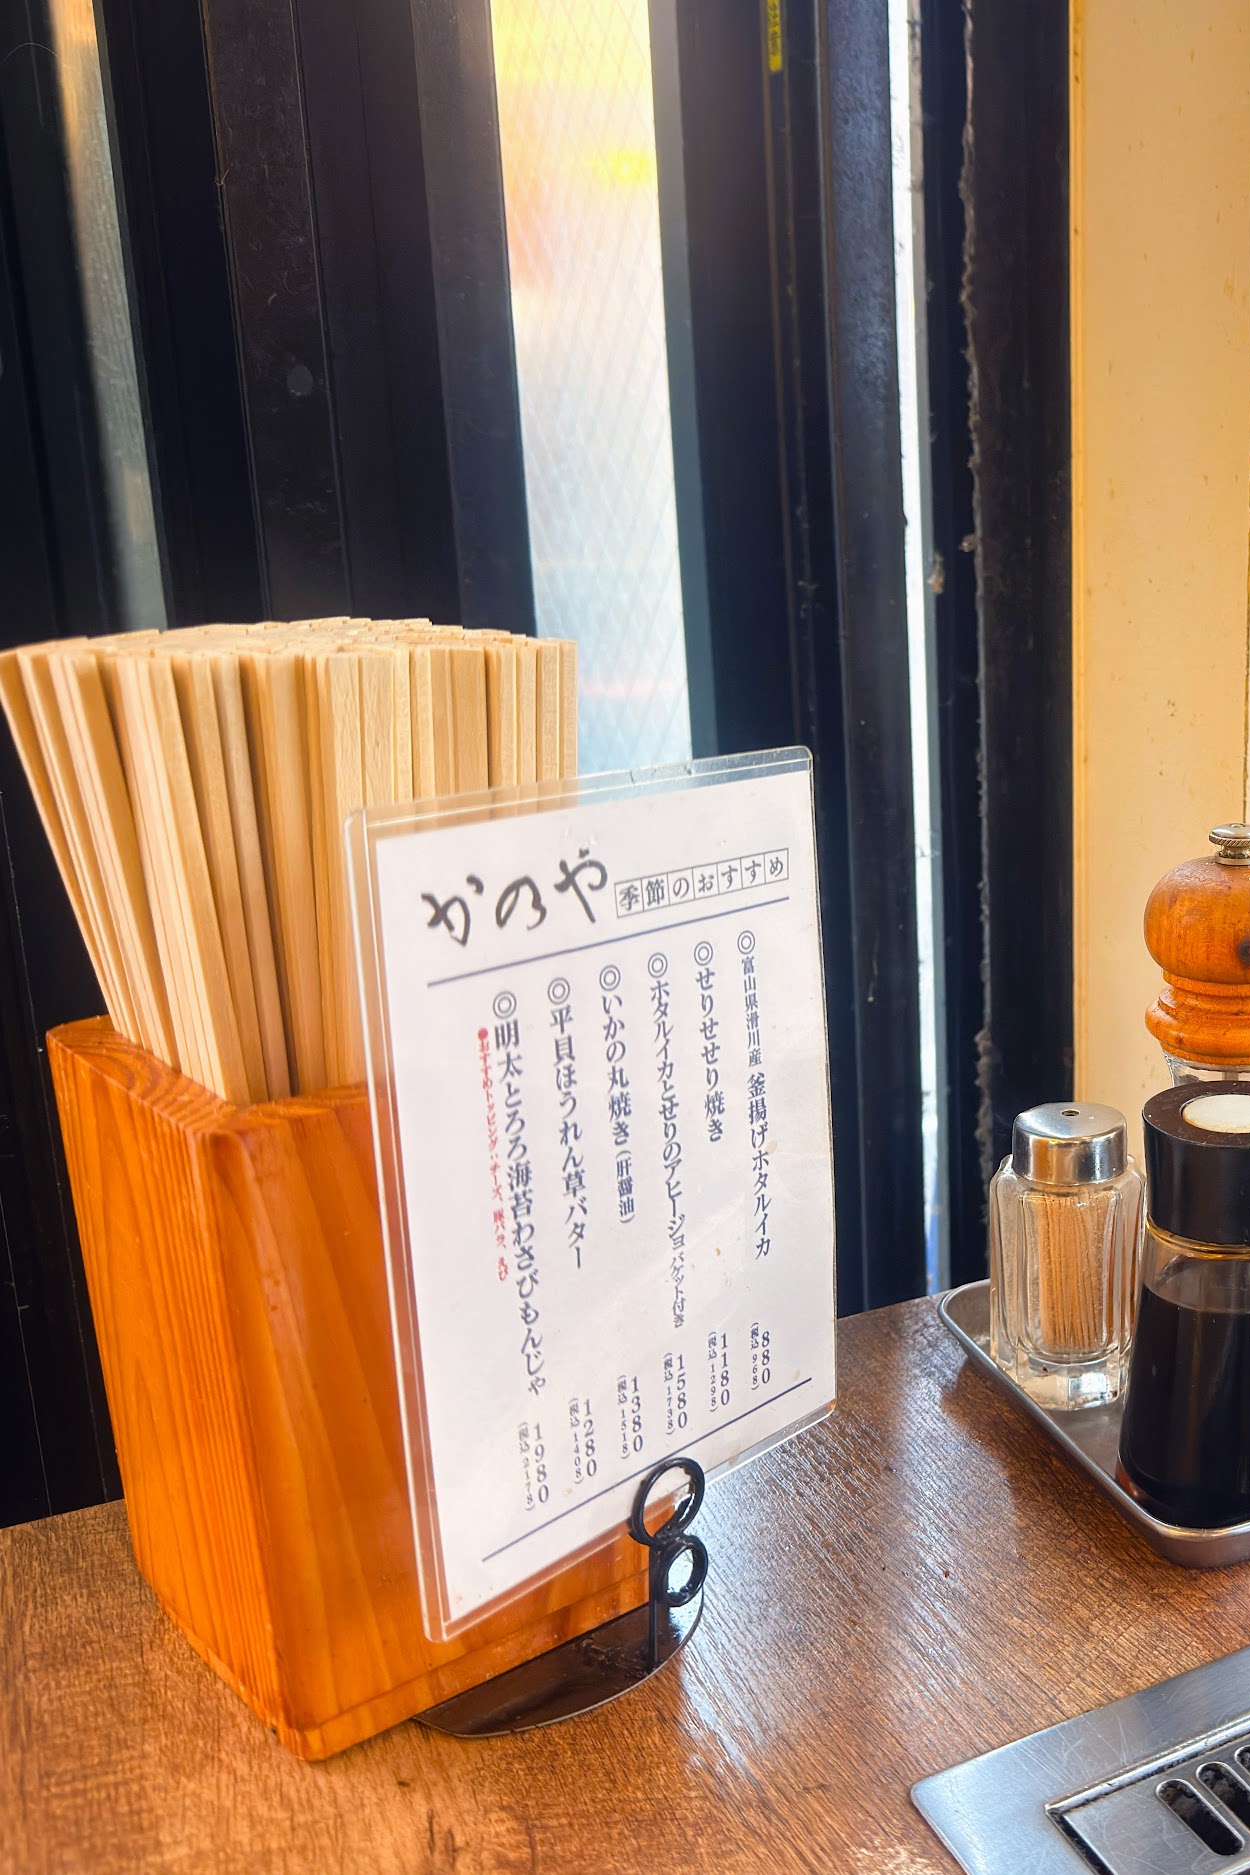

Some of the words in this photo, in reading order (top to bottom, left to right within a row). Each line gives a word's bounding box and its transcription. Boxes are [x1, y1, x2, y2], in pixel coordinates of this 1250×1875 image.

[421, 848, 608, 947] かのや
[619, 856, 785, 912] 季節のおすすめ
[742, 953, 762, 1067] 富山県滑川産
[696, 965, 725, 1142] せりせせり焼き
[721, 1333, 730, 1405] 1180
[748, 1072, 771, 1260] 釜揚げホタルイカ
[494, 1018, 547, 1397] 明太とろろ海苔わさびもんじゃ
[533, 1422, 549, 1504] 1980
[549, 1004, 587, 1270] 平貝ほうれん草バター
[584, 1399, 597, 1477] 1280
[677, 1354, 687, 1428] 1580
[761, 1331, 770, 1384] 880
[631, 1375, 644, 1453] 1380
